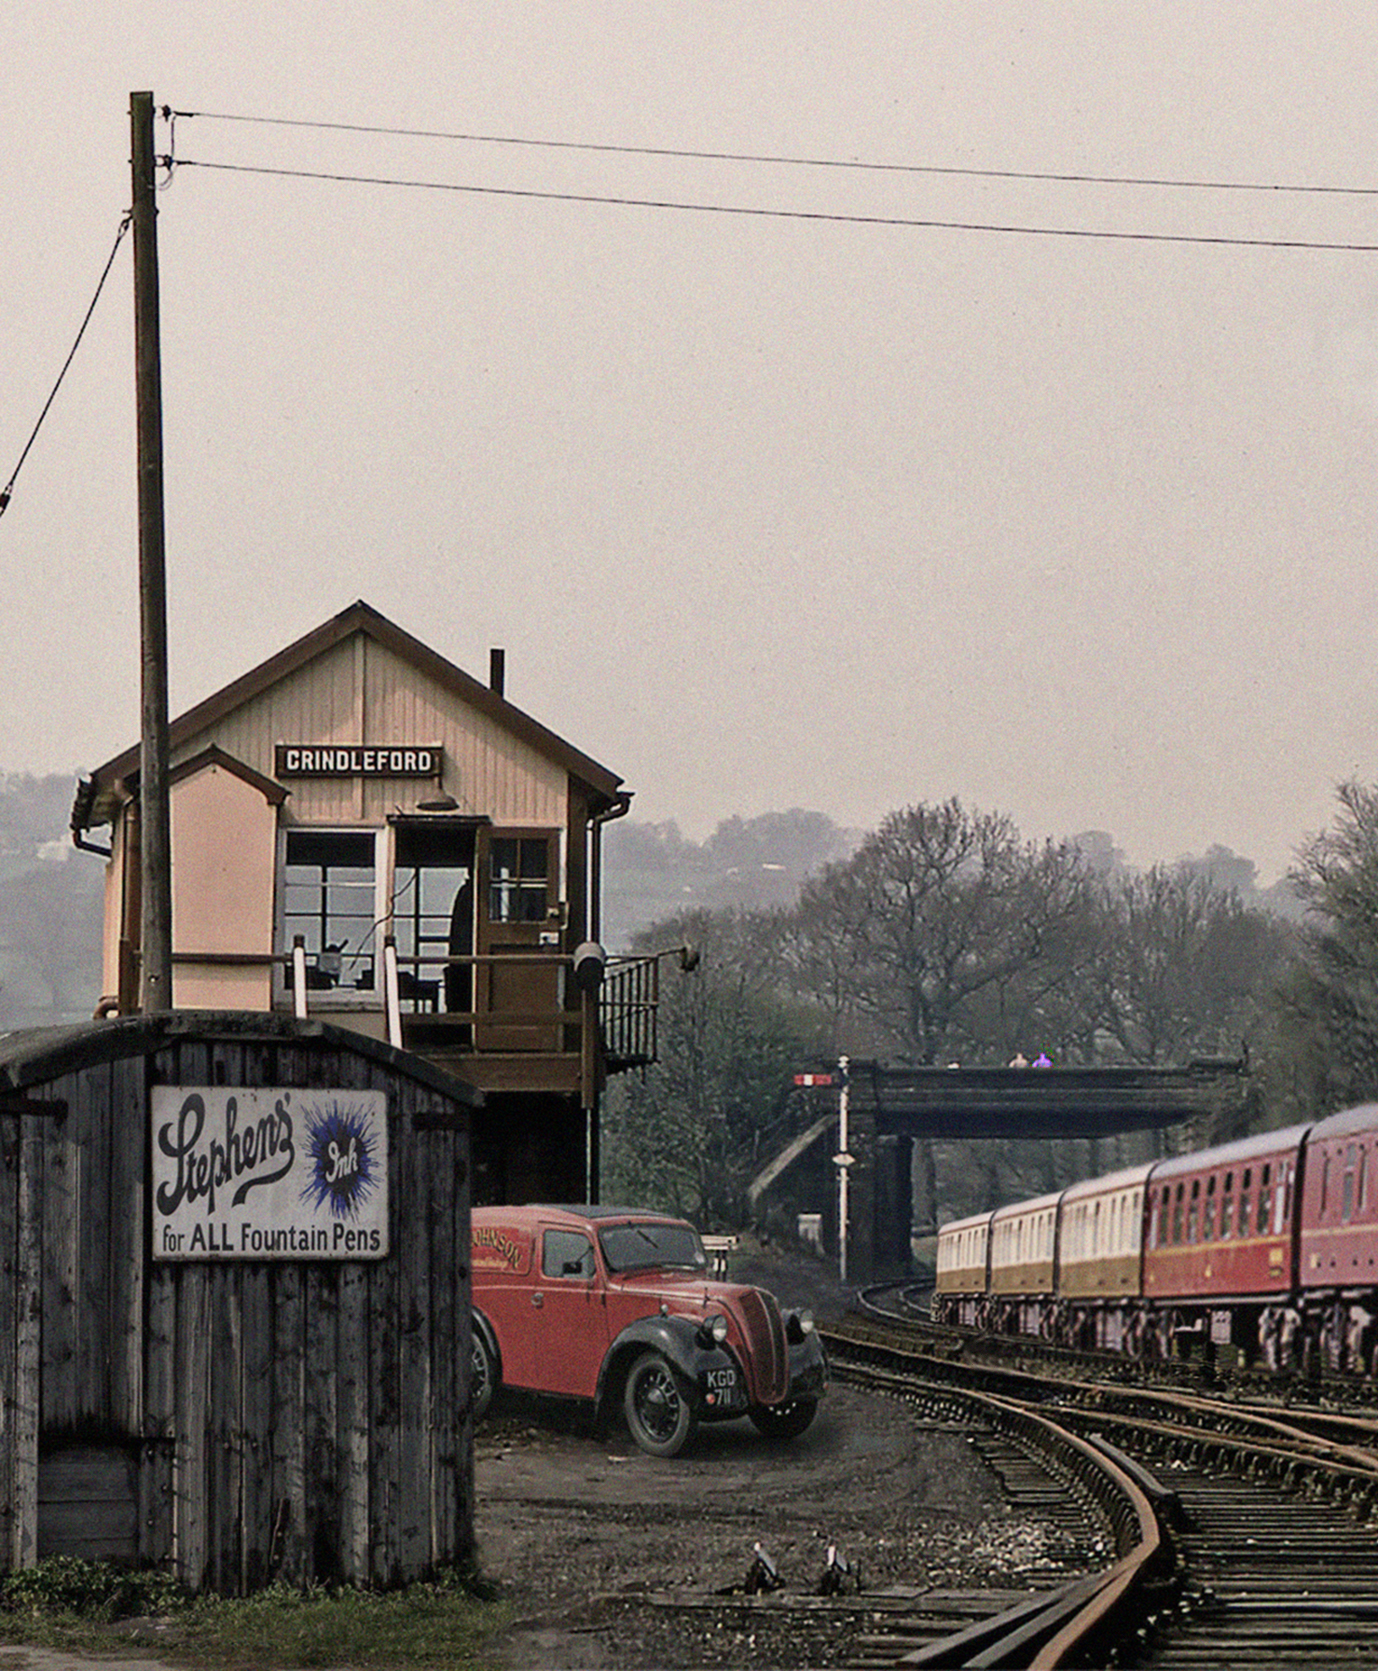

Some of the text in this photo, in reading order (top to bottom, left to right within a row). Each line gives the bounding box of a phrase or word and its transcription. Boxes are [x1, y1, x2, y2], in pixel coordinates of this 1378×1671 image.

[325, 1137, 359, 1183] Ink
[163, 1223, 381, 1251] for ALL Fountain Pens
[471, 1228, 523, 1270] OHNSON
[706, 1369, 736, 1388] KGD
[714, 1388, 732, 1406] 711
